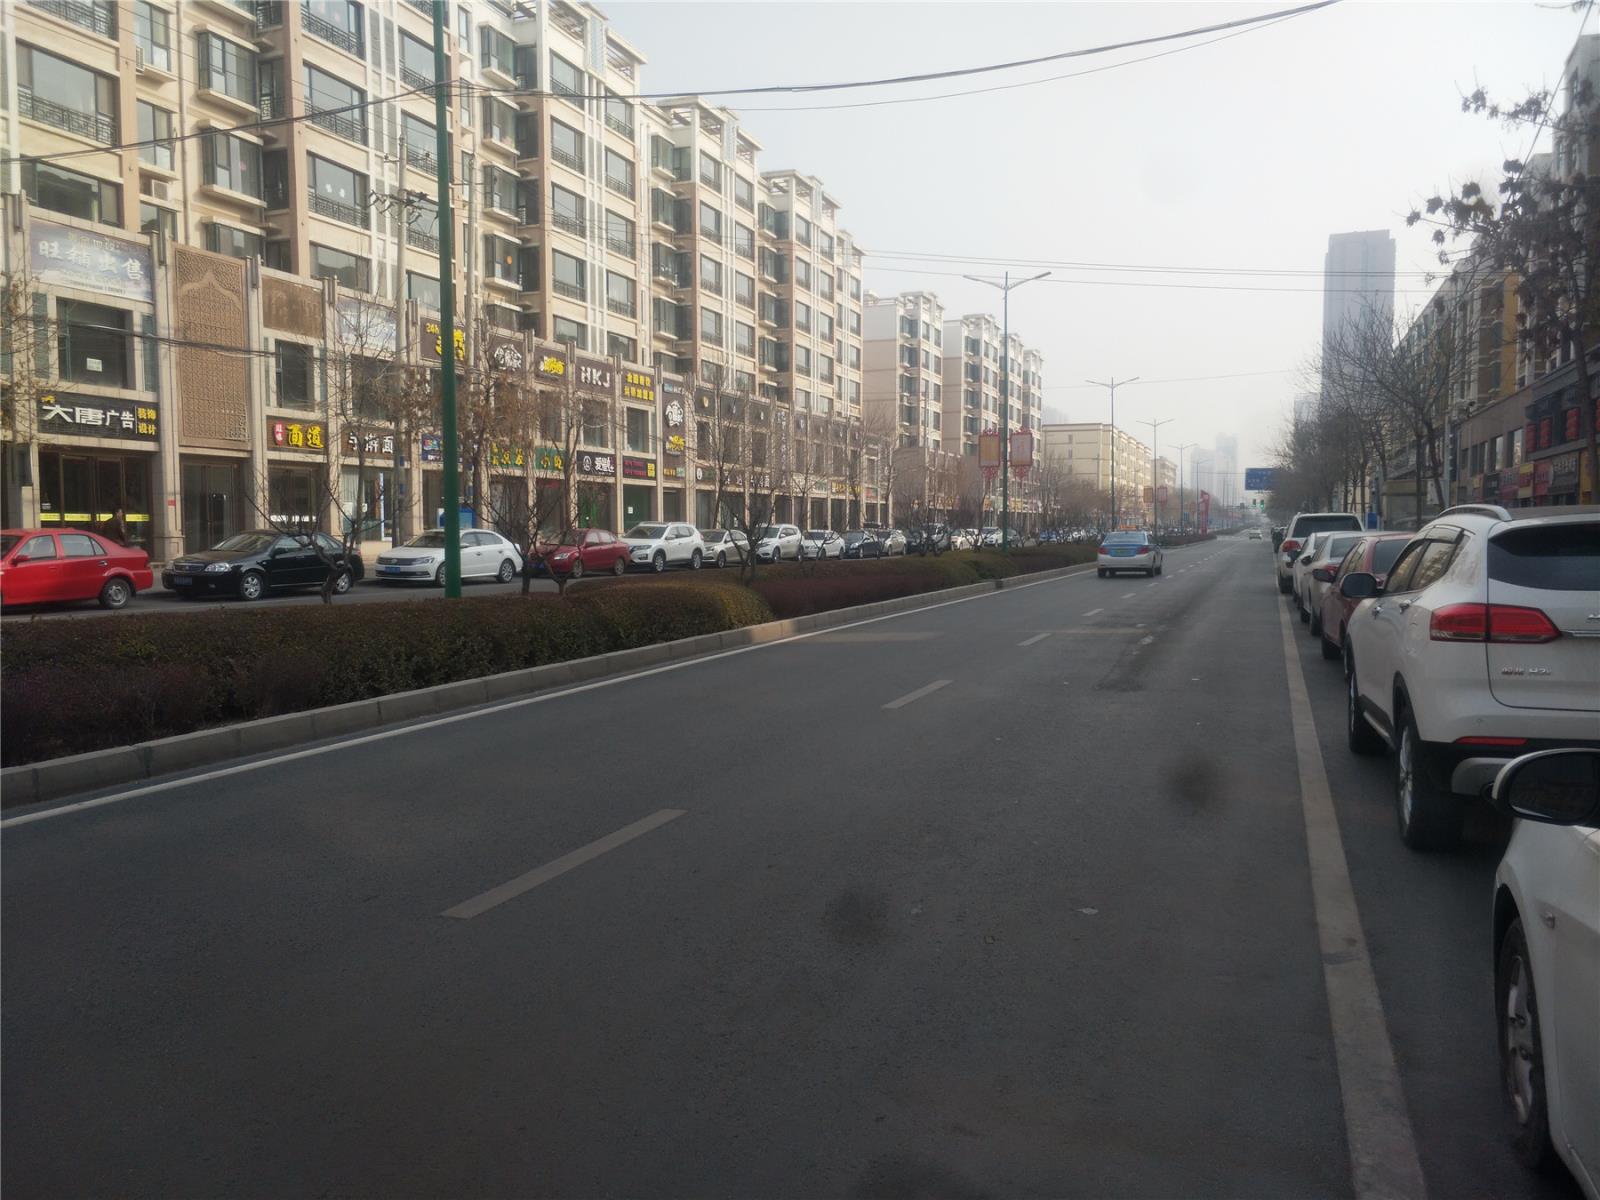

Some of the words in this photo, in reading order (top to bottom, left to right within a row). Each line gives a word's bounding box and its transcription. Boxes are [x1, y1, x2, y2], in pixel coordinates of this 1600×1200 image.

[41, 404, 135, 429] 大唐广告
[138, 422, 157, 436] 设计
